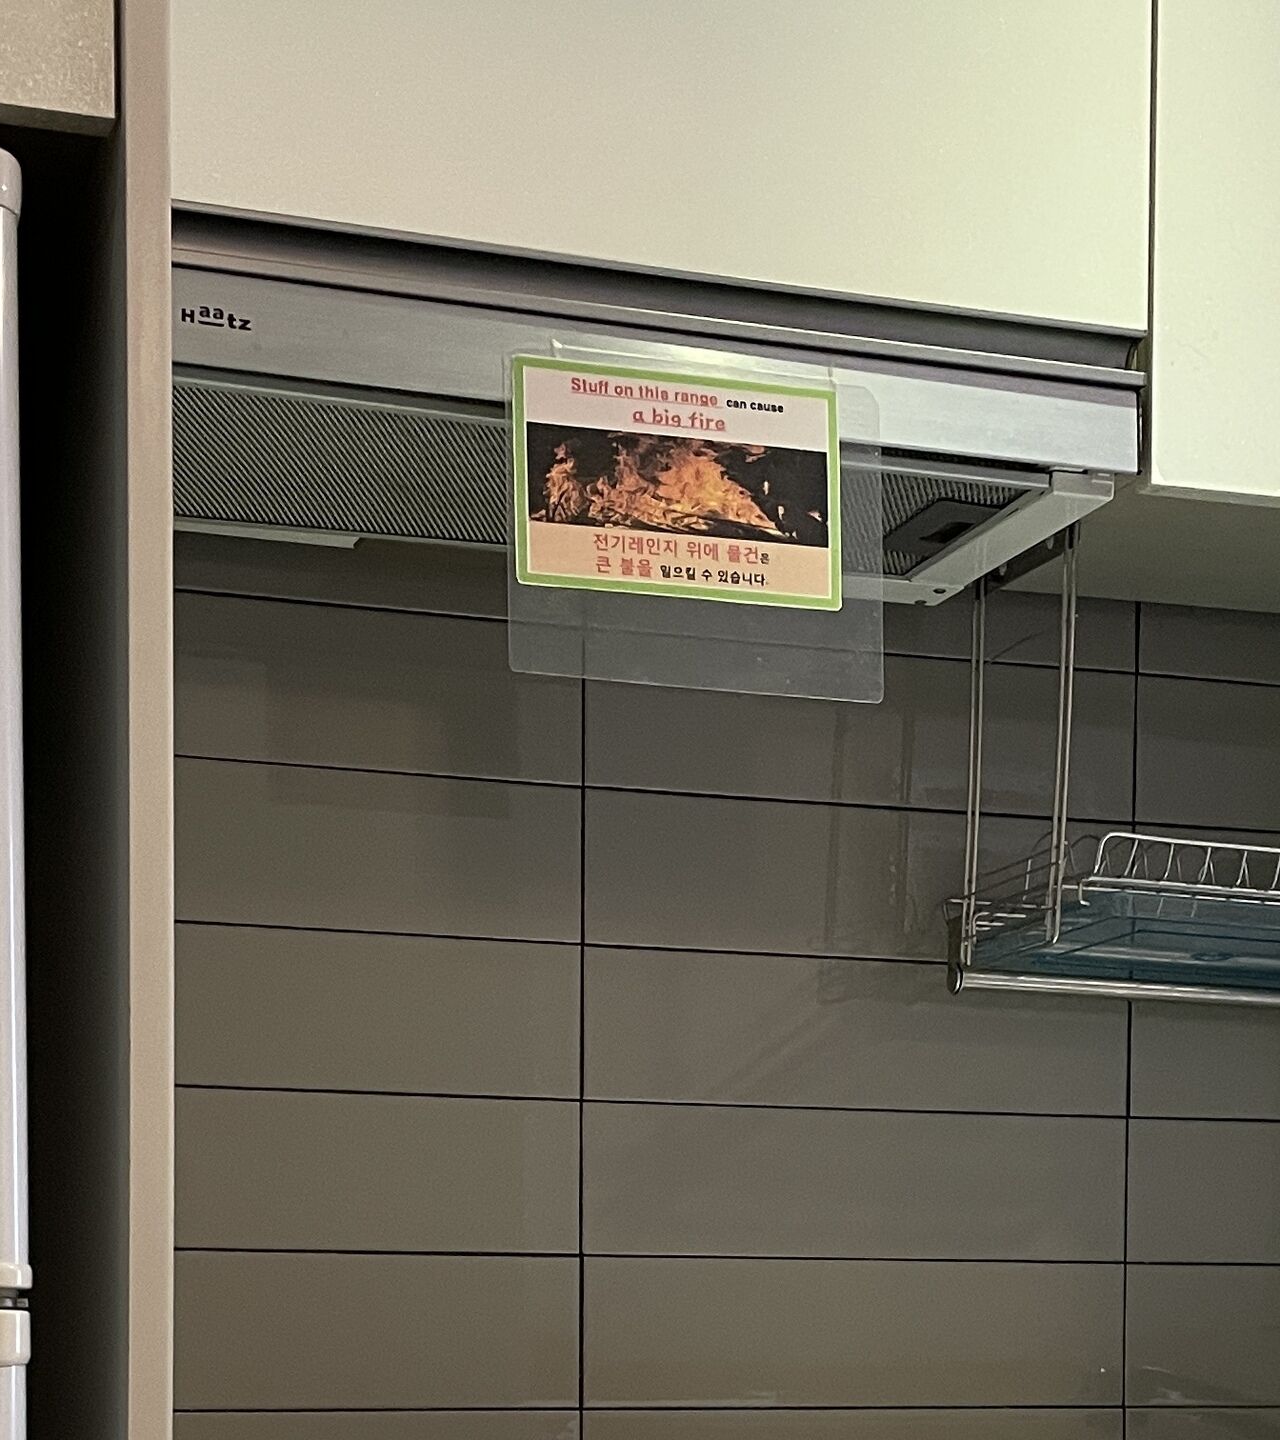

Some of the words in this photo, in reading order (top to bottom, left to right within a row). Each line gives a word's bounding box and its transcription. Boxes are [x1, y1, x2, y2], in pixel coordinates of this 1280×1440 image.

[181, 306, 252, 331] Haatz
[571, 377, 609, 395] Stuff
[614, 385, 634, 397] on
[638, 385, 669, 401] this
[674, 391, 718, 407] range
[726, 399, 747, 410] can
[750, 401, 784, 413] cause
[632, 410, 644, 424] a
[652, 408, 682, 428] big
[688, 411, 726, 431] fire
[593, 533, 678, 557] 전기레인지
[687, 541, 719, 561] 위에
[727, 544, 770, 565] 물건은
[595, 555, 611, 574] 큰
[620, 557, 653, 577] 불을
[660, 564, 696, 581] 일으킬
[701, 569, 713, 582] 수
[717, 569, 768, 587] 있습니다.
